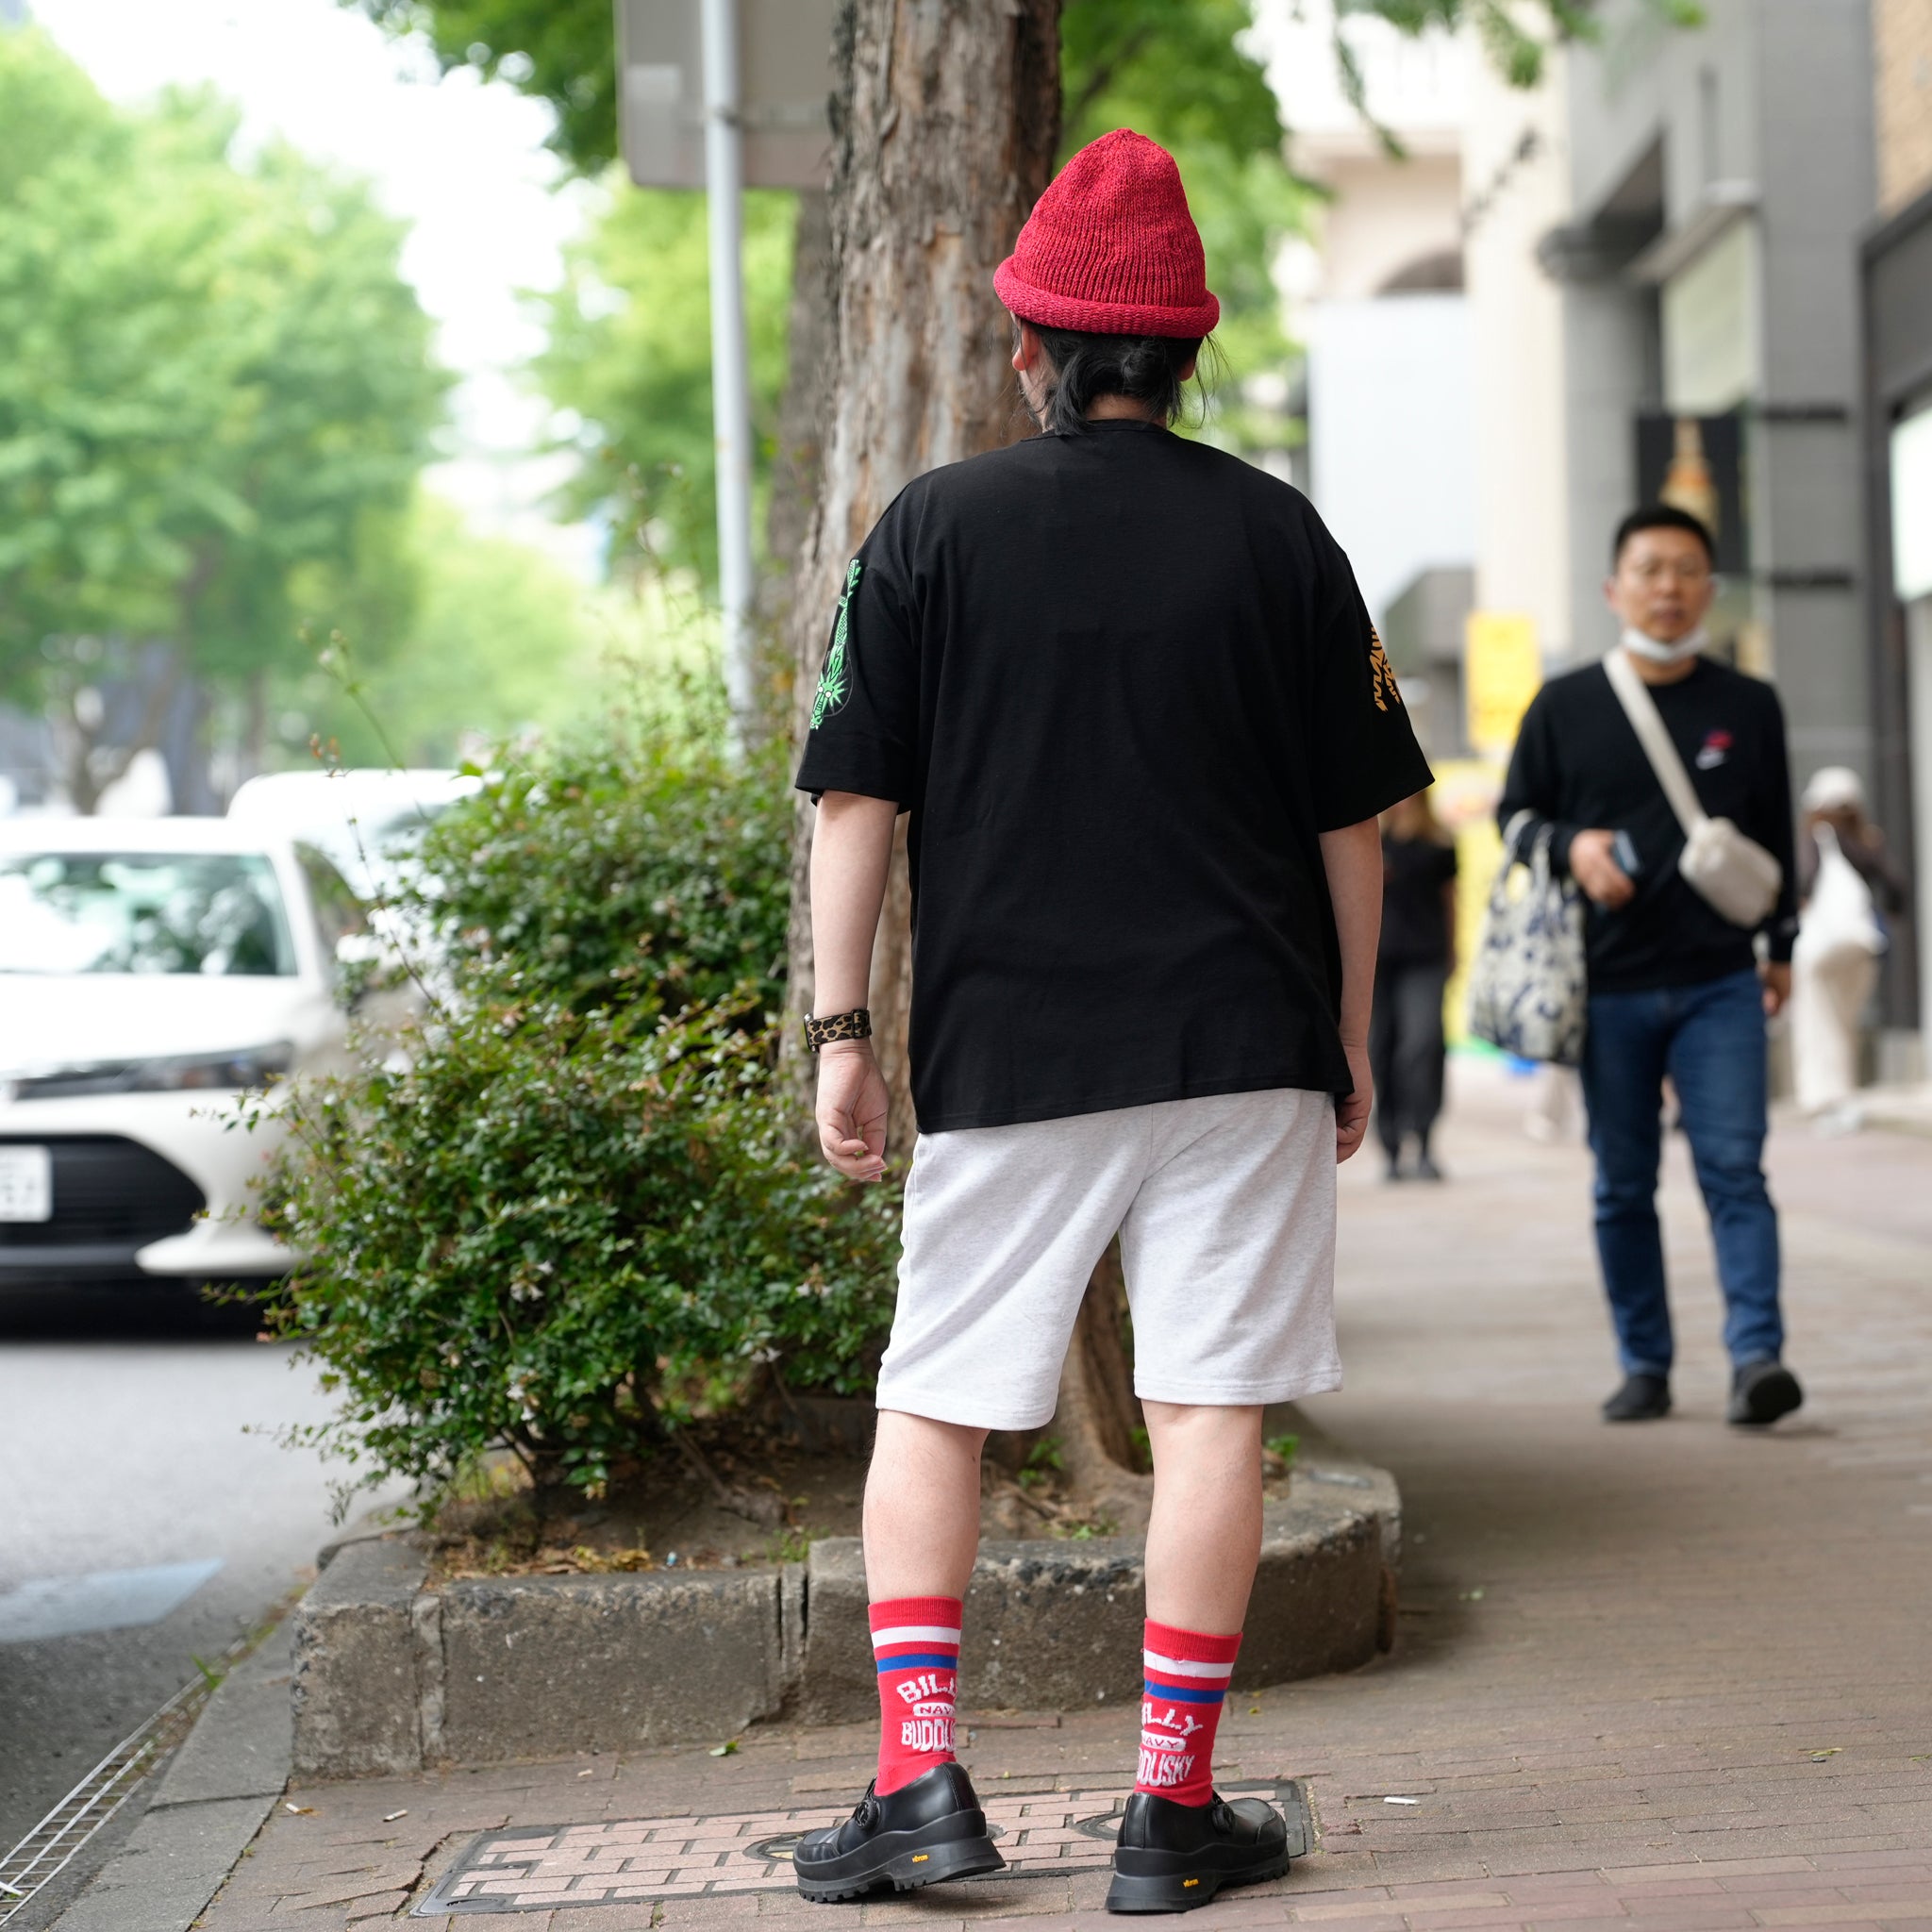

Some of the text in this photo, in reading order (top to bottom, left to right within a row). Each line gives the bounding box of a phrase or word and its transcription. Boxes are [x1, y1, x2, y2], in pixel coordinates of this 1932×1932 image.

[896, 1674, 957, 1704] BILL
[920, 1706, 953, 1715] NAV
[1141, 1702, 1204, 1736] ILLY
[1143, 1736, 1180, 1749] AVY
